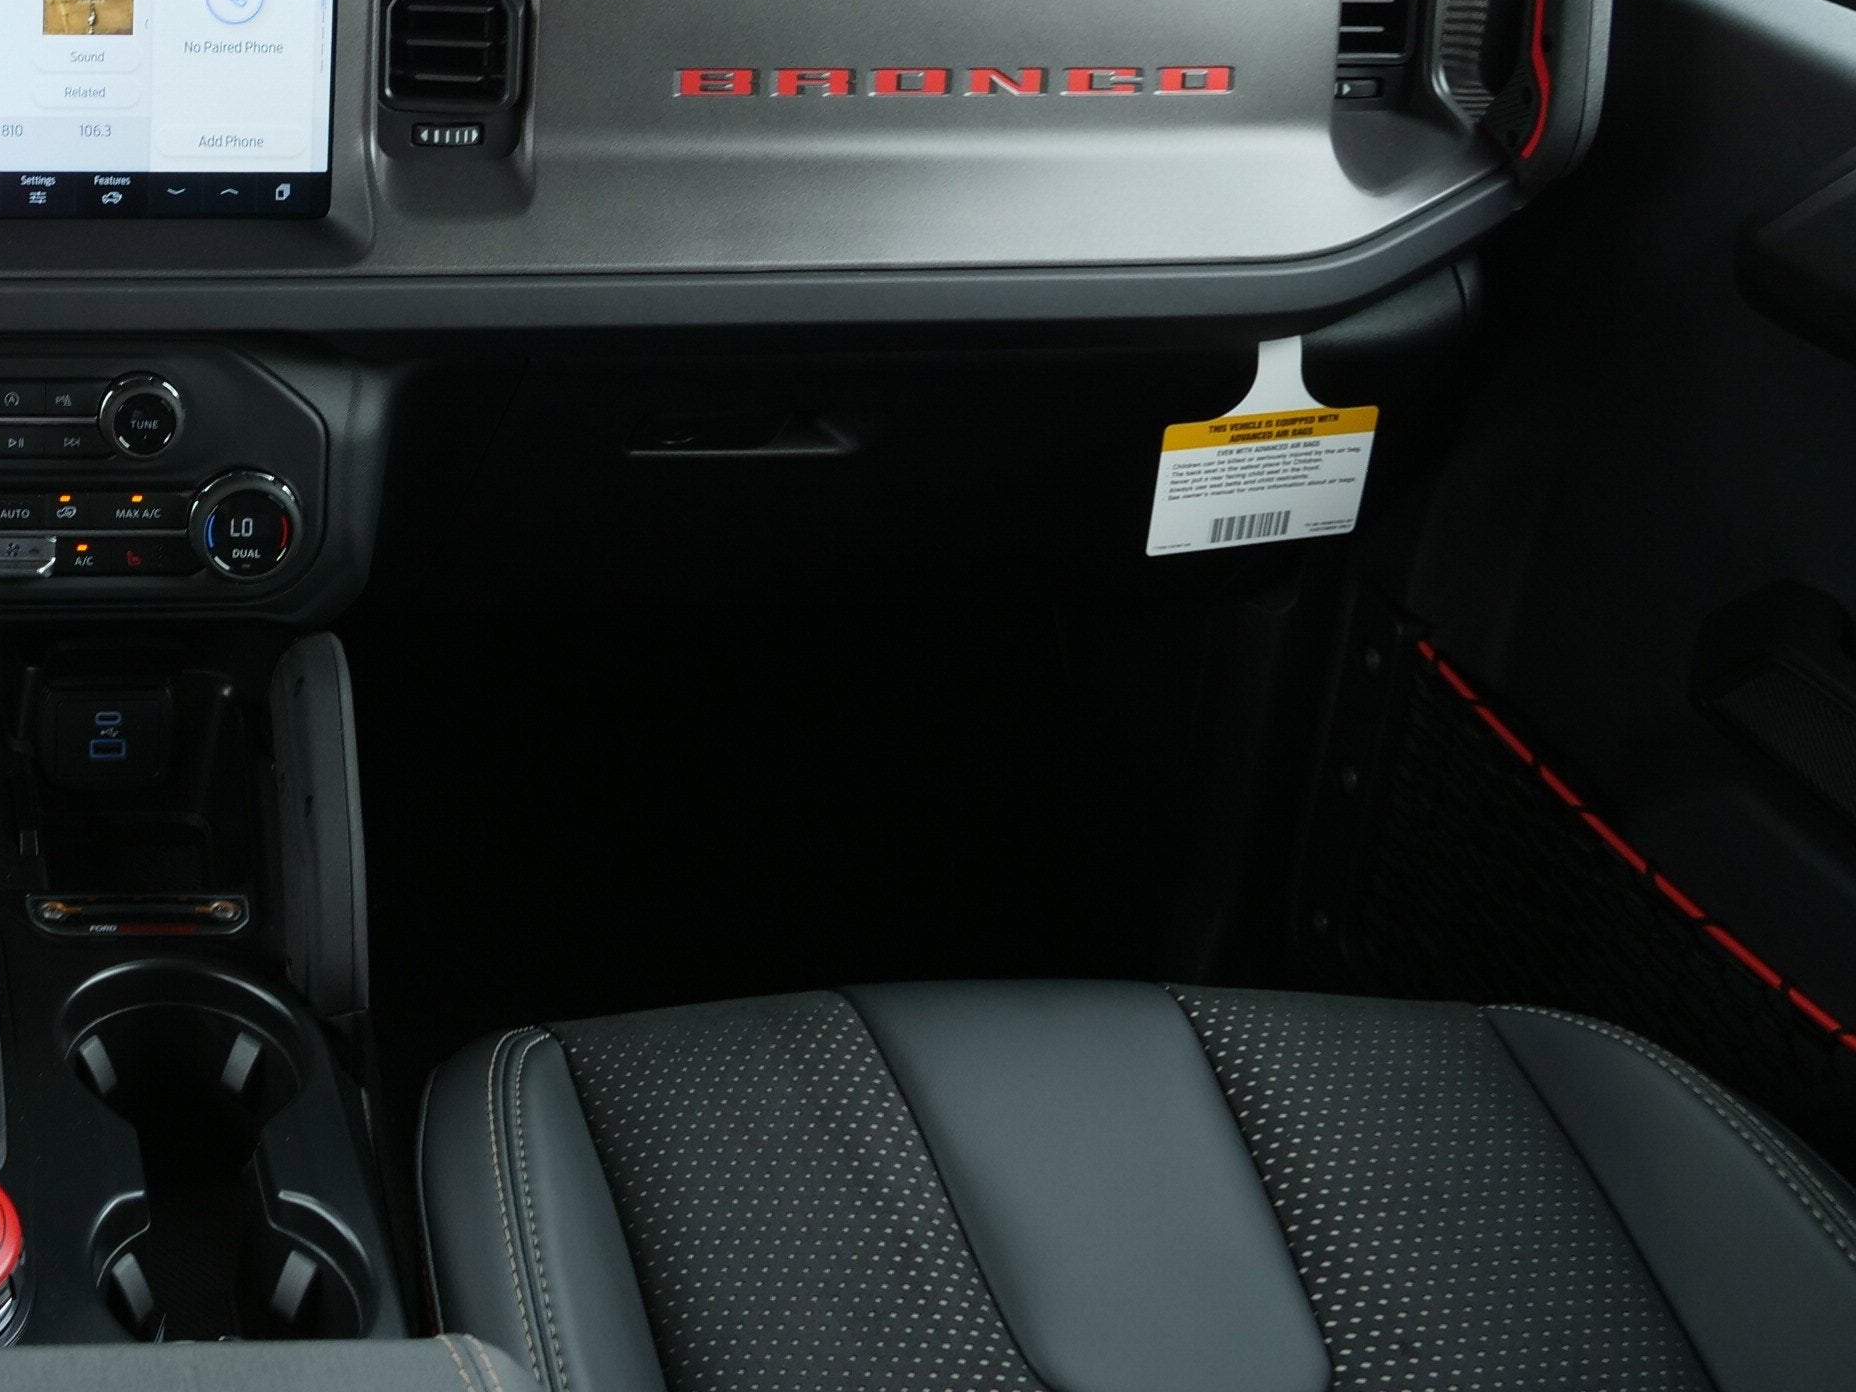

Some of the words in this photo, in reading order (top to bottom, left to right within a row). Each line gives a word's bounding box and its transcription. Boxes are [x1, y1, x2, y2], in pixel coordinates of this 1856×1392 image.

[183, 41, 200, 54] No
[203, 41, 243, 54] Paired
[244, 41, 284, 55] Phone
[69, 50, 106, 63] Sound
[671, 65, 1237, 99] BRONCO
[63, 86, 106, 99] Related
[0, 124, 24, 137] 810
[79, 124, 113, 138] 106.3
[197, 135, 224, 149] Add
[225, 135, 264, 149] Phone
[19, 174, 57, 189] Settings
[93, 175, 131, 187] Features
[129, 418, 159, 431] TUNE
[0, 508, 31, 520] AUTO
[114, 508, 141, 520] MAX
[141, 508, 162, 520] A/C
[73, 554, 94, 566] A/C
[231, 548, 261, 560] DUAL
[88, 923, 118, 933] FORD
